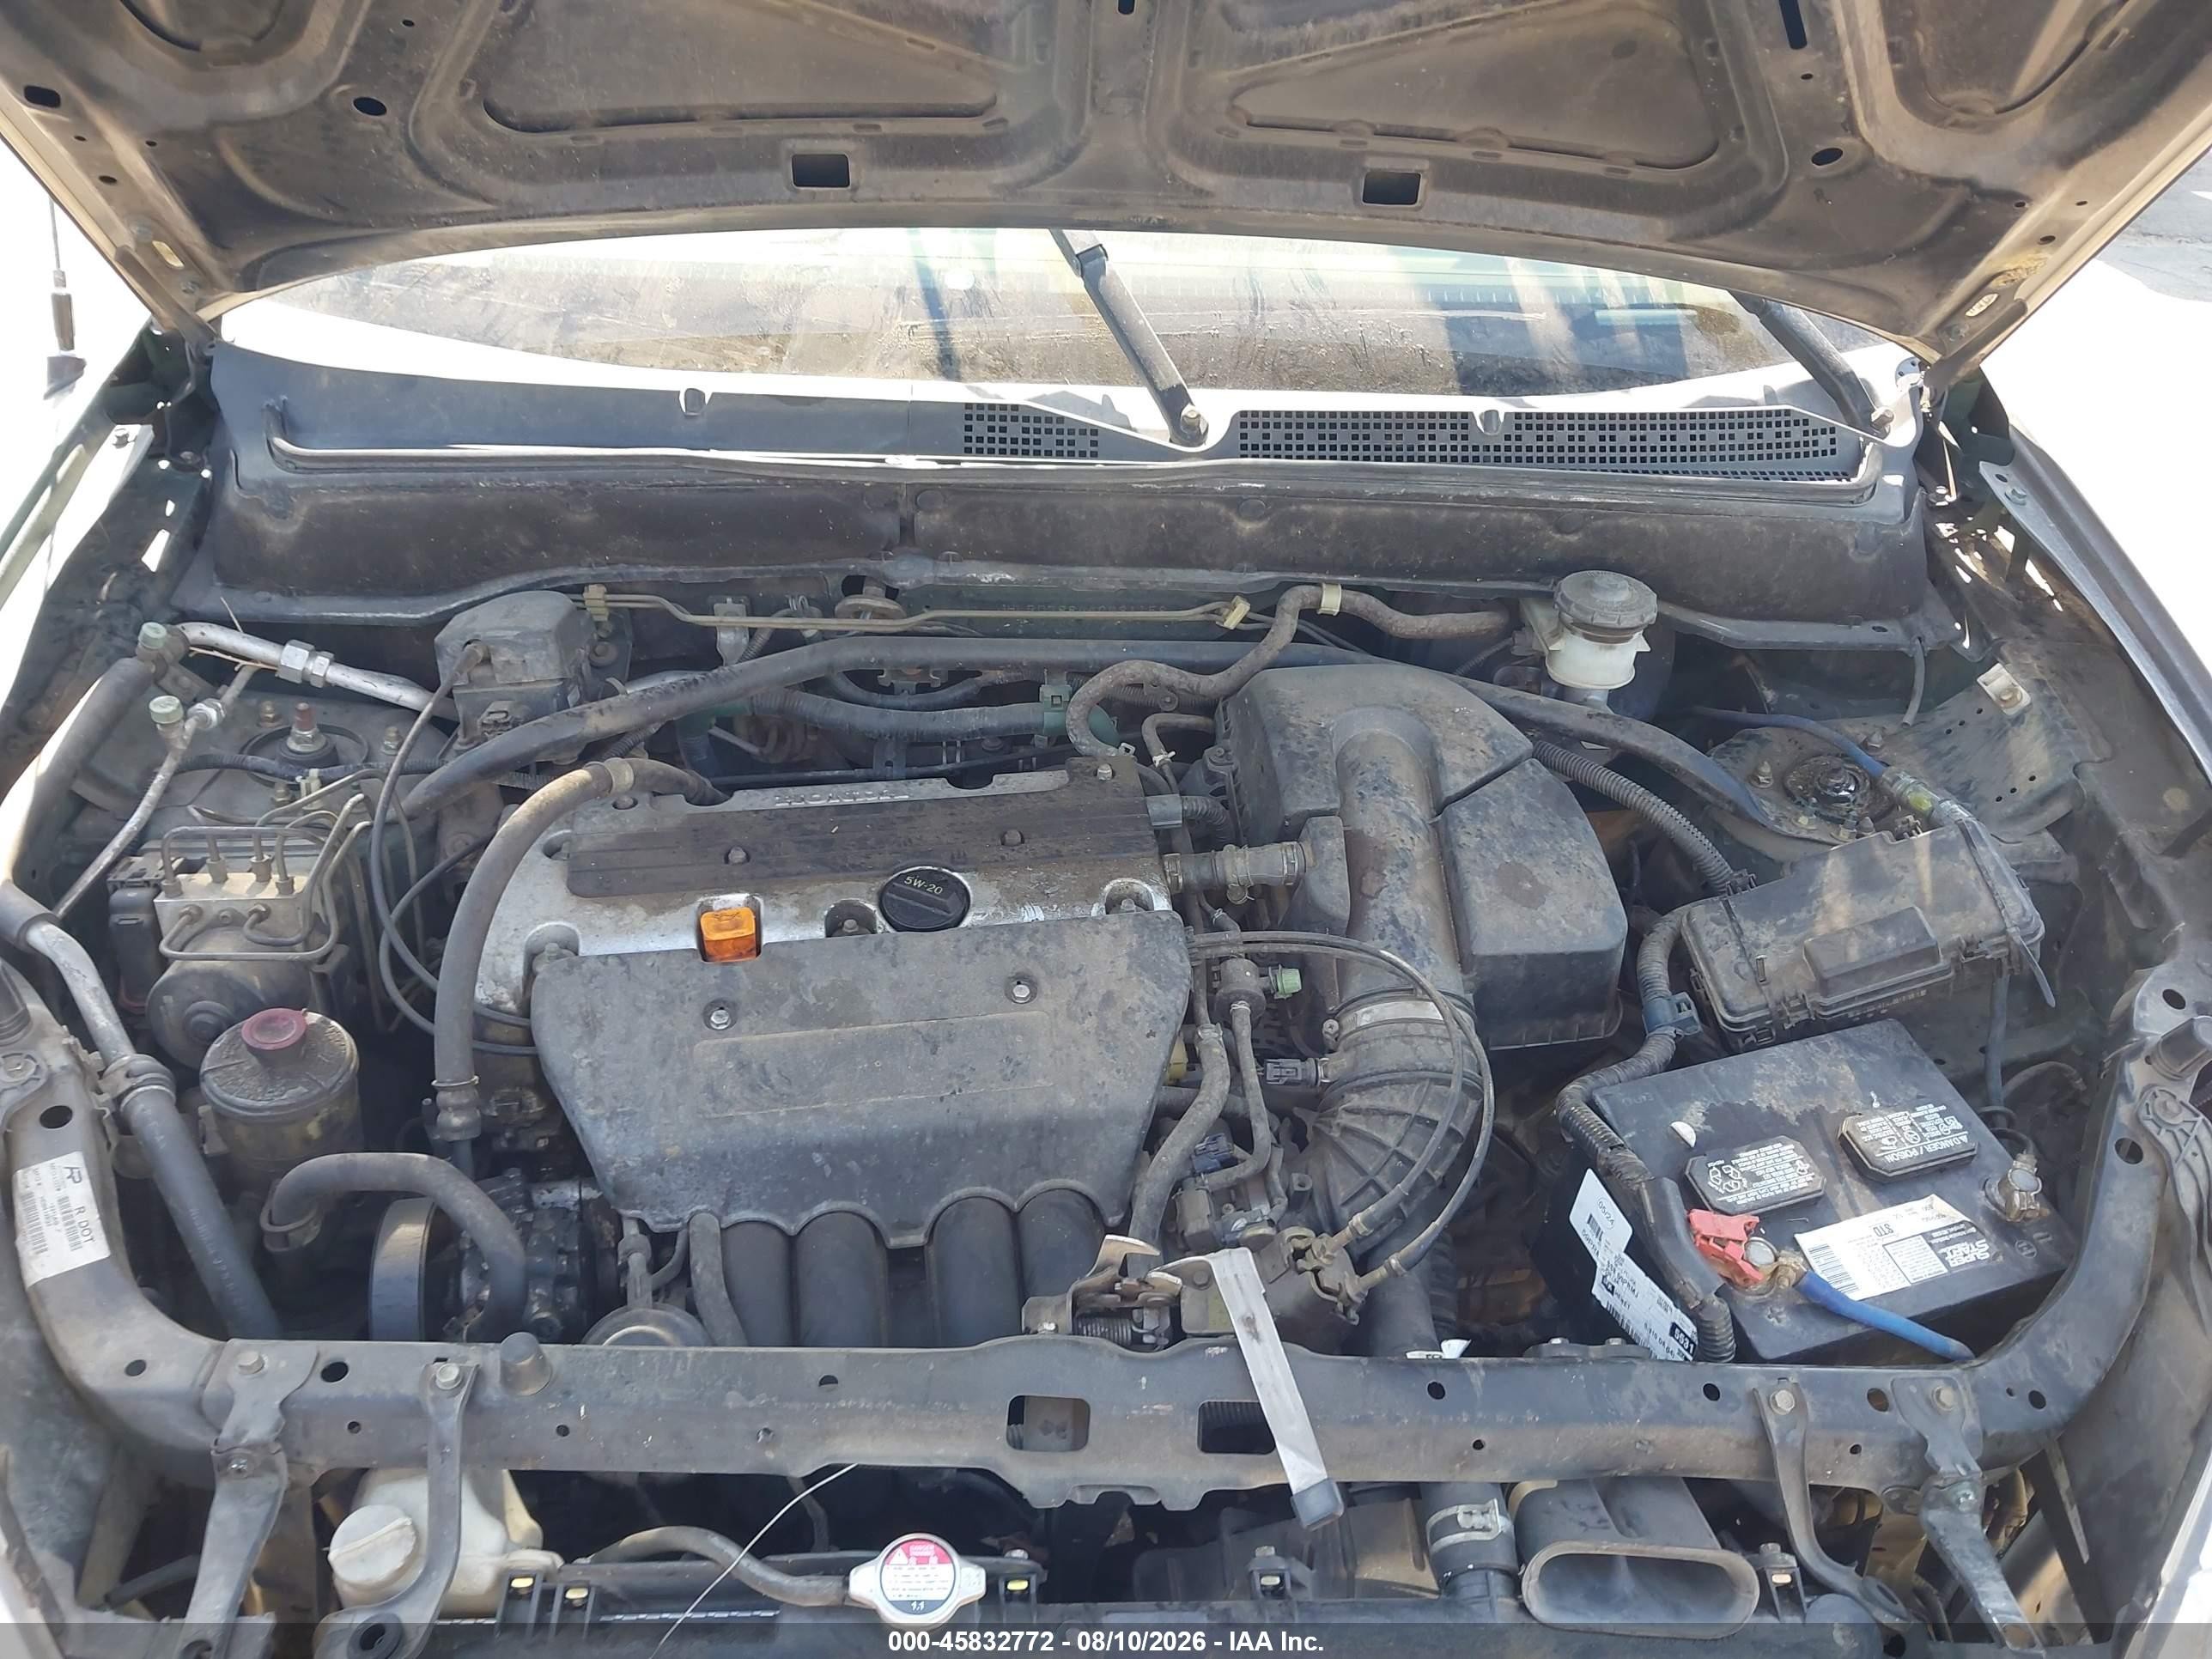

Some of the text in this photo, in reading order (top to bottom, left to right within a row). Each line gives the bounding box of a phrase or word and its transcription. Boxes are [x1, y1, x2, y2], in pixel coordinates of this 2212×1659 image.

[904, 876, 943, 894] 5W-20
[1927, 1137, 1964, 1152] DANGER
[1885, 1149, 1919, 1164] POISON
[74, 1206, 95, 1243] R DOT
[1873, 1223, 1894, 1237] STD
[1945, 1239, 1990, 1259] START
[1948, 1251, 1990, 1268] SUPER
[1674, 1328, 1695, 1354] 5531
[911, 1601, 925, 1611] 1.1
